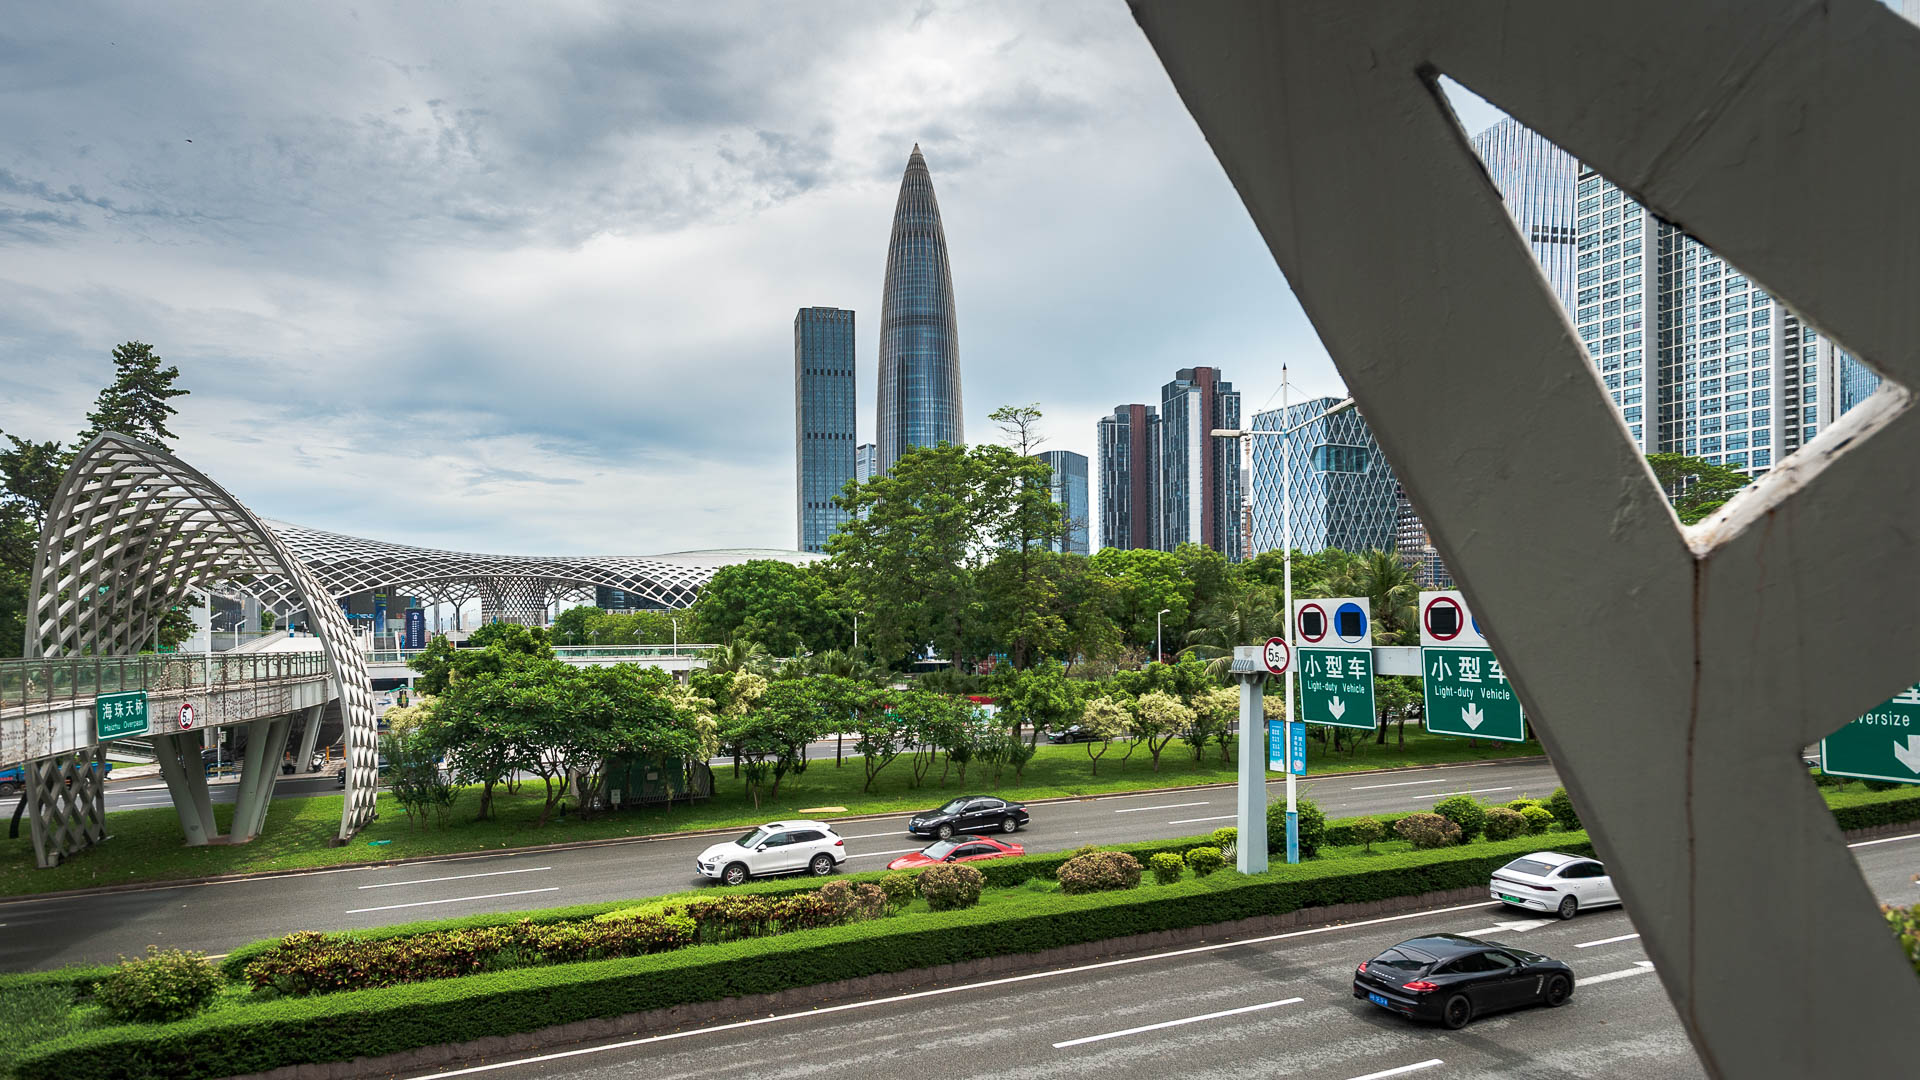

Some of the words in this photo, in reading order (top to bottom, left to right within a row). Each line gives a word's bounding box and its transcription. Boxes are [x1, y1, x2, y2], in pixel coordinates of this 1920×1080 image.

[1305, 654, 1366, 680] 小型车
[1431, 655, 1507, 684] 小型车
[1307, 680, 1337, 693] Light-duty
[1342, 682, 1365, 694] Vehicle
[1434, 685, 1474, 700] Light-duty
[1480, 687, 1510, 700] Vehicle
[102, 698, 144, 720] 海珠天桥
[1851, 711, 1910, 727] versize
